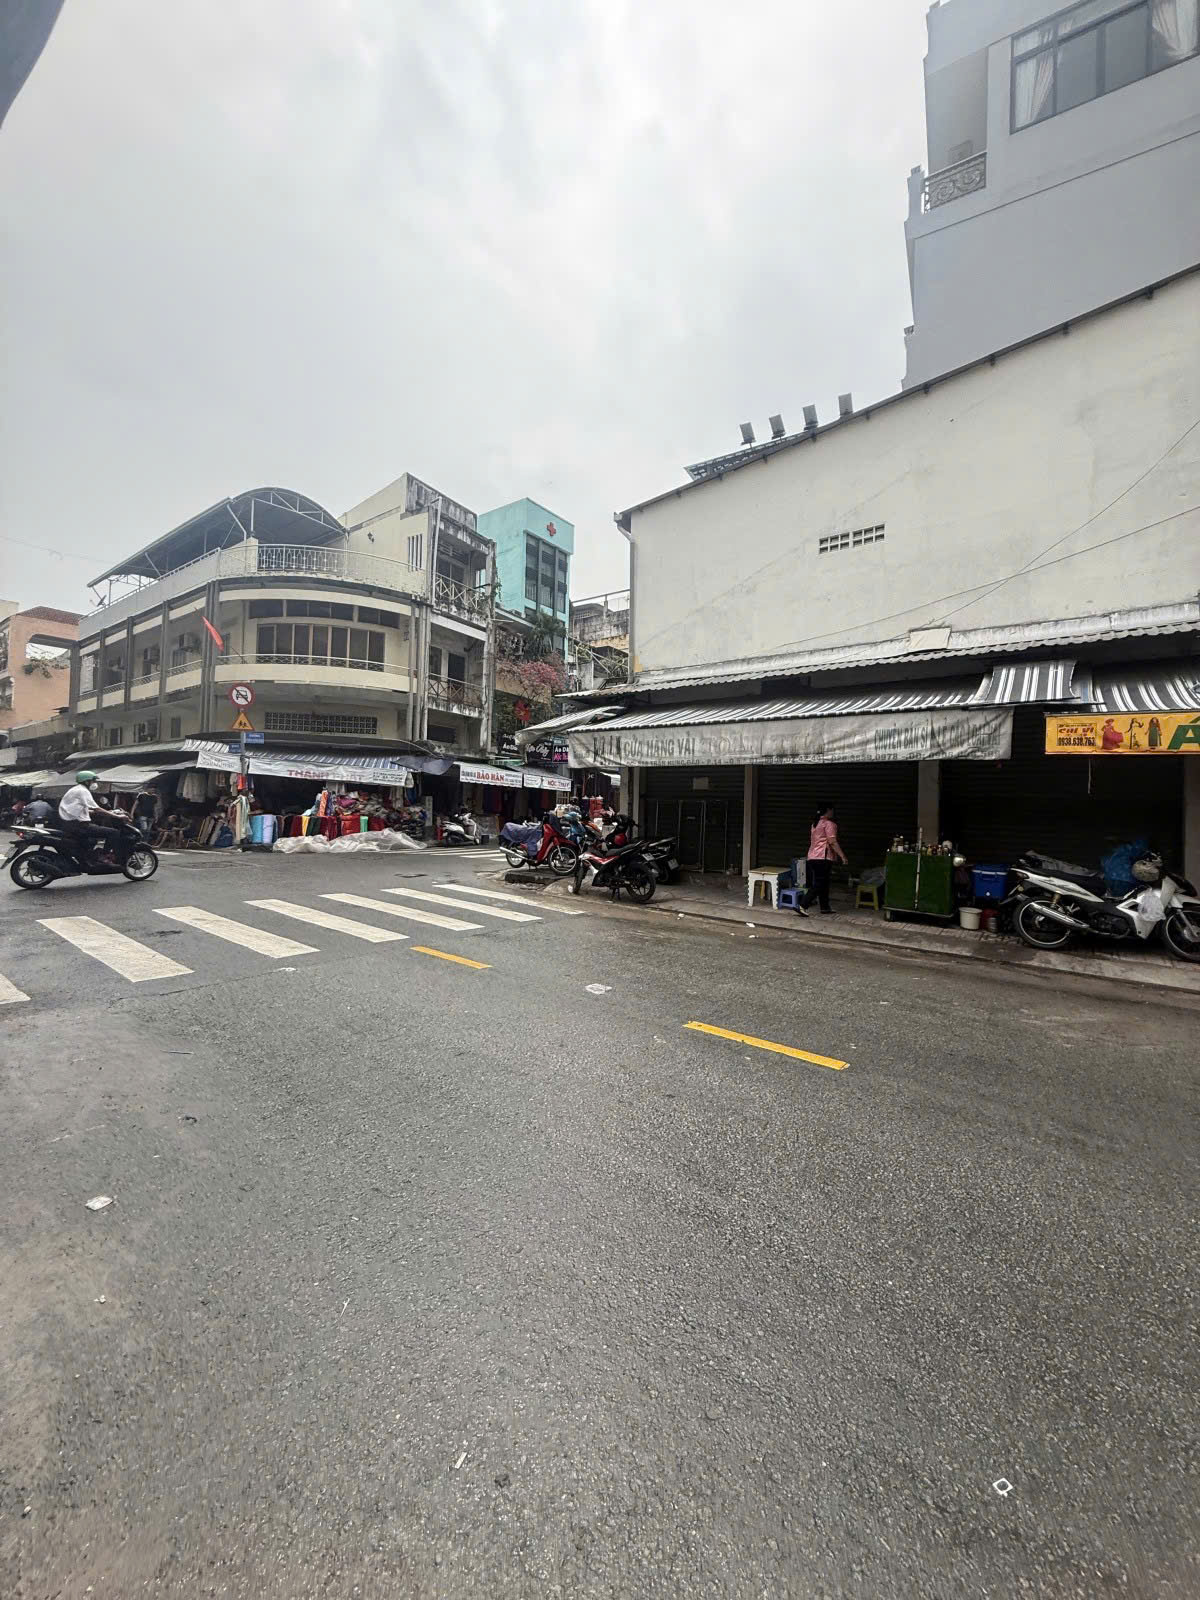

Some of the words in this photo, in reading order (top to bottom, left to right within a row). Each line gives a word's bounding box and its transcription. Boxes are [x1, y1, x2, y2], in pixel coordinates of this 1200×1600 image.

[646, 735, 675, 757] HÀNG
[677, 731, 696, 757] VẢI
[903, 721, 919, 749] BÁN
